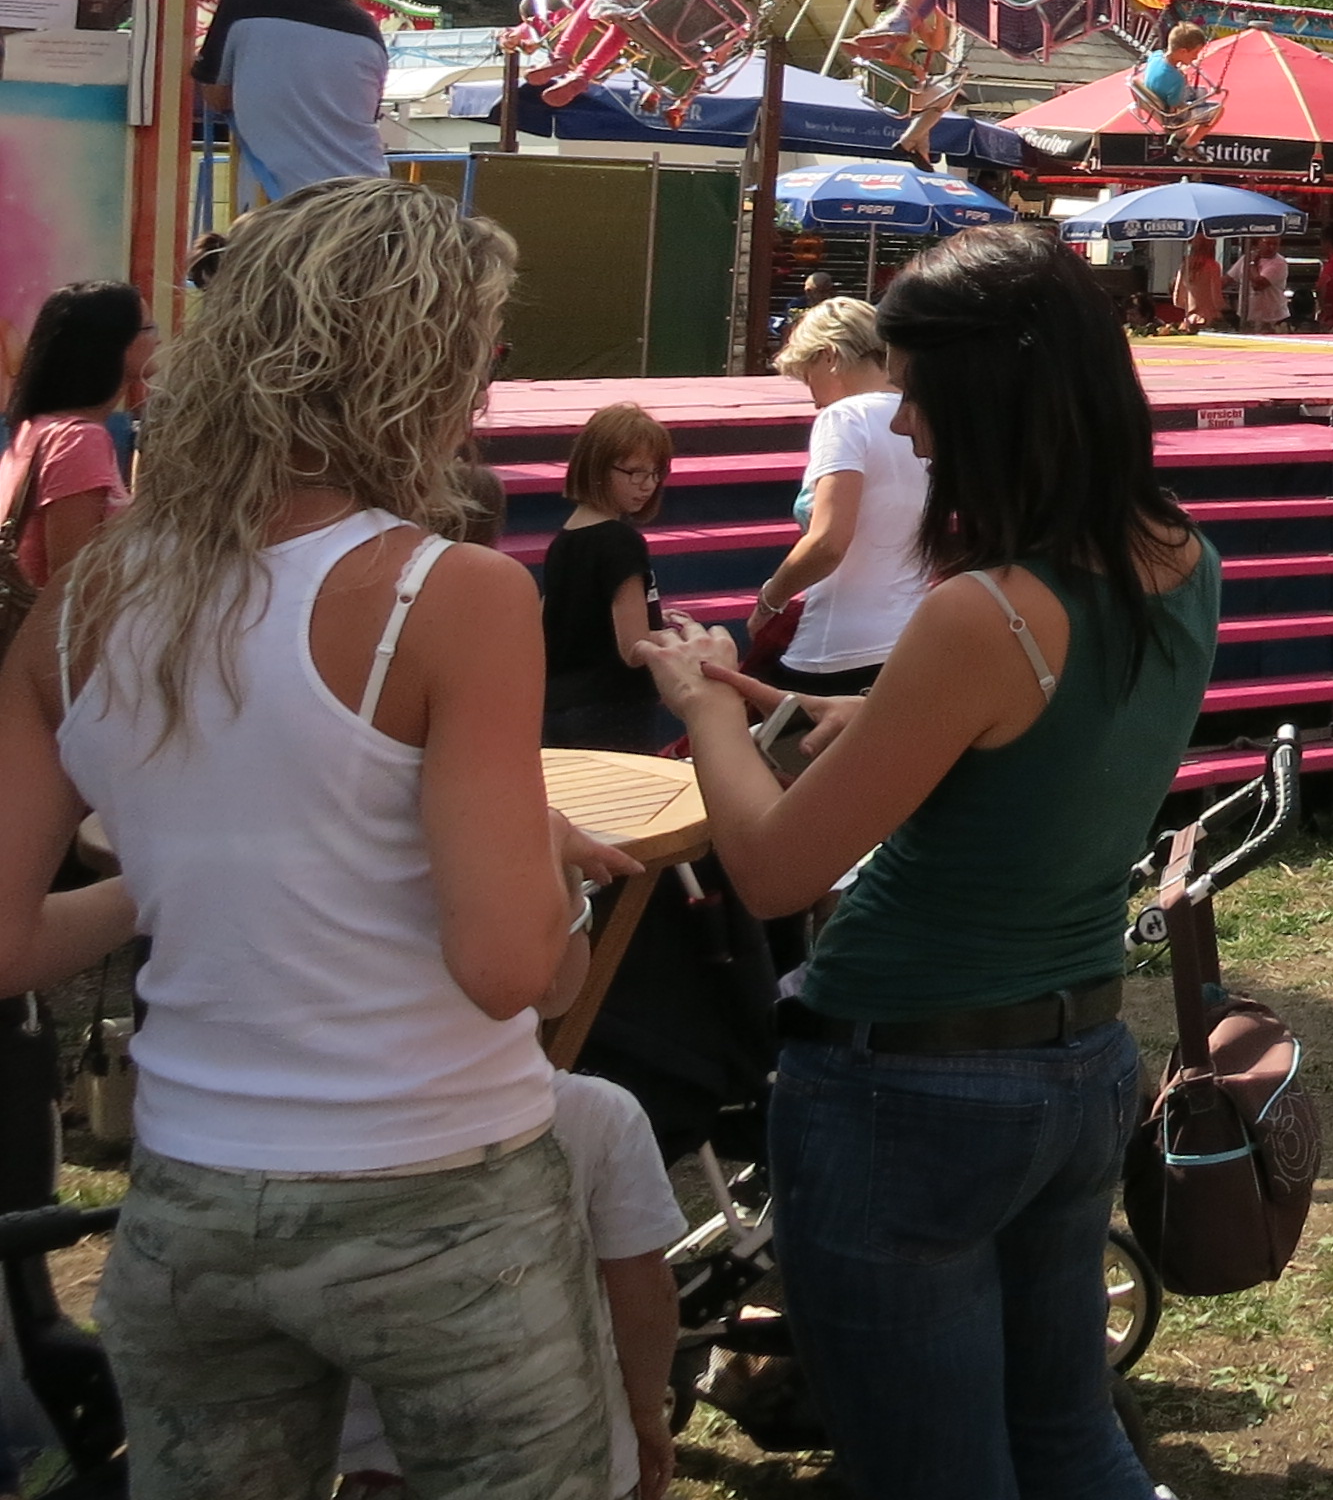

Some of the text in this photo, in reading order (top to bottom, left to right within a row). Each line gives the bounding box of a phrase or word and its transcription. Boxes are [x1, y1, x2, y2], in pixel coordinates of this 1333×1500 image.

[834, 173, 906, 187] PEPSI
[856, 204, 895, 215] PEPSI
[965, 210, 991, 221] PEPSI
[1143, 220, 1185, 232] GESSNER
[1200, 410, 1243, 419] Vorsicht
